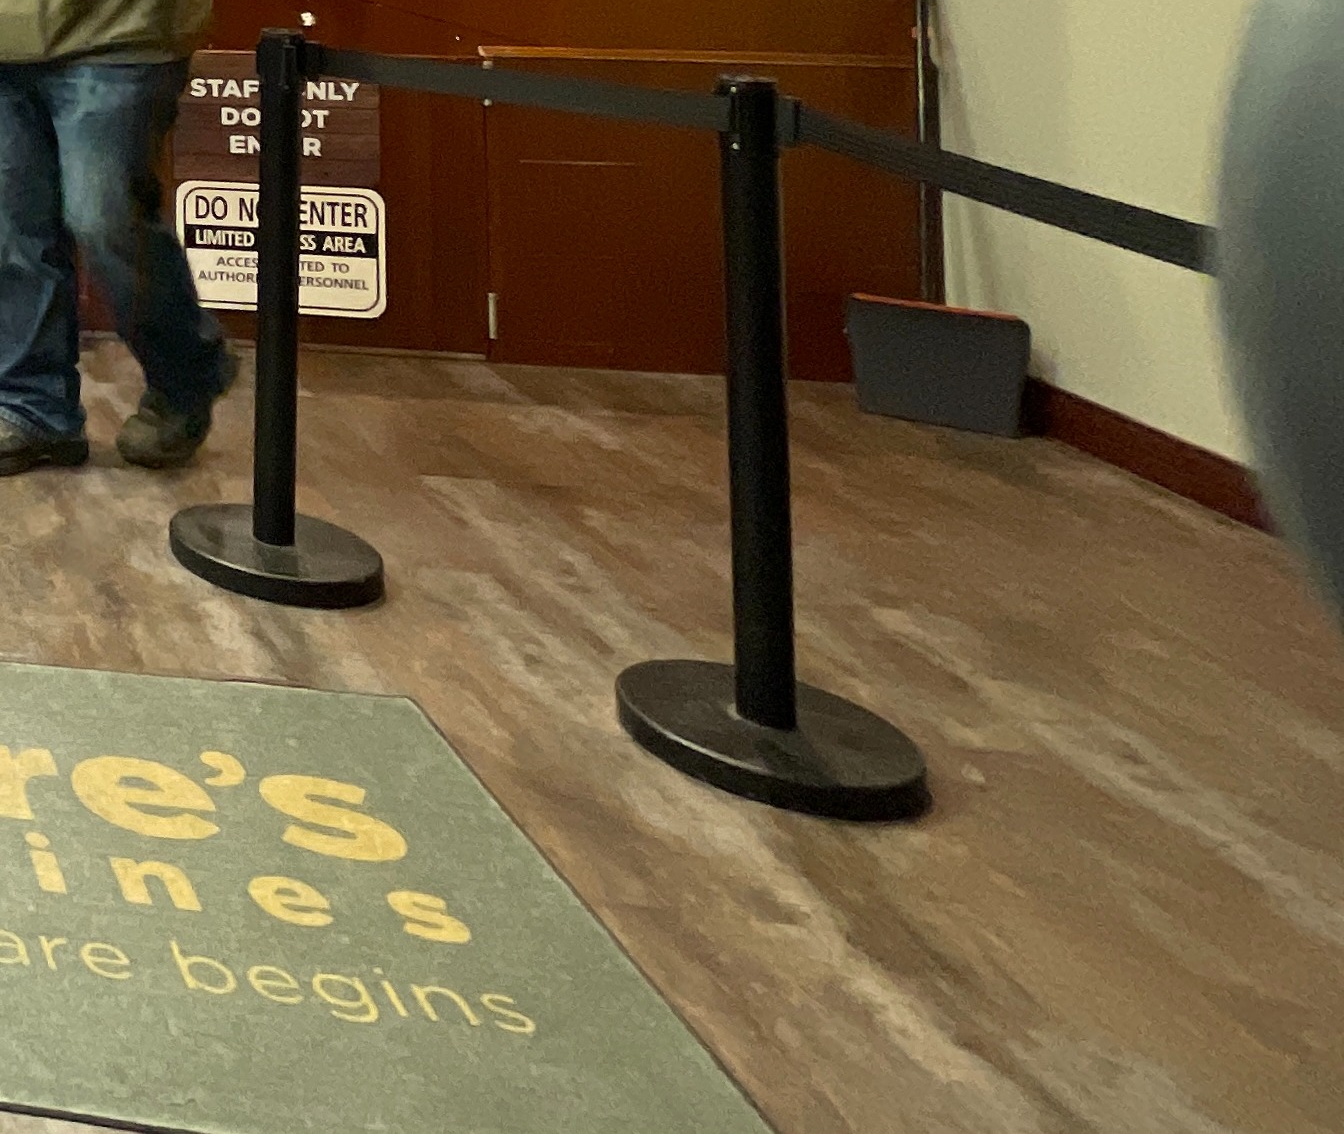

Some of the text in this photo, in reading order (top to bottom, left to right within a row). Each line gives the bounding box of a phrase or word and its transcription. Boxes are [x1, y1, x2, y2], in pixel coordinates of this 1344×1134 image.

[190, 78, 360, 101] STAF NLY
[220, 107, 260, 126] DO
[195, 195, 228, 221] DO
[299, 200, 368, 228] ENTER
[195, 228, 255, 247] LIMITED
[322, 236, 366, 254] AREA
[216, 256, 259, 268] ACCES
[331, 262, 350, 274] TO
[299, 276, 369, 291] ERSONNEL
[170, 939, 537, 1037] begins
